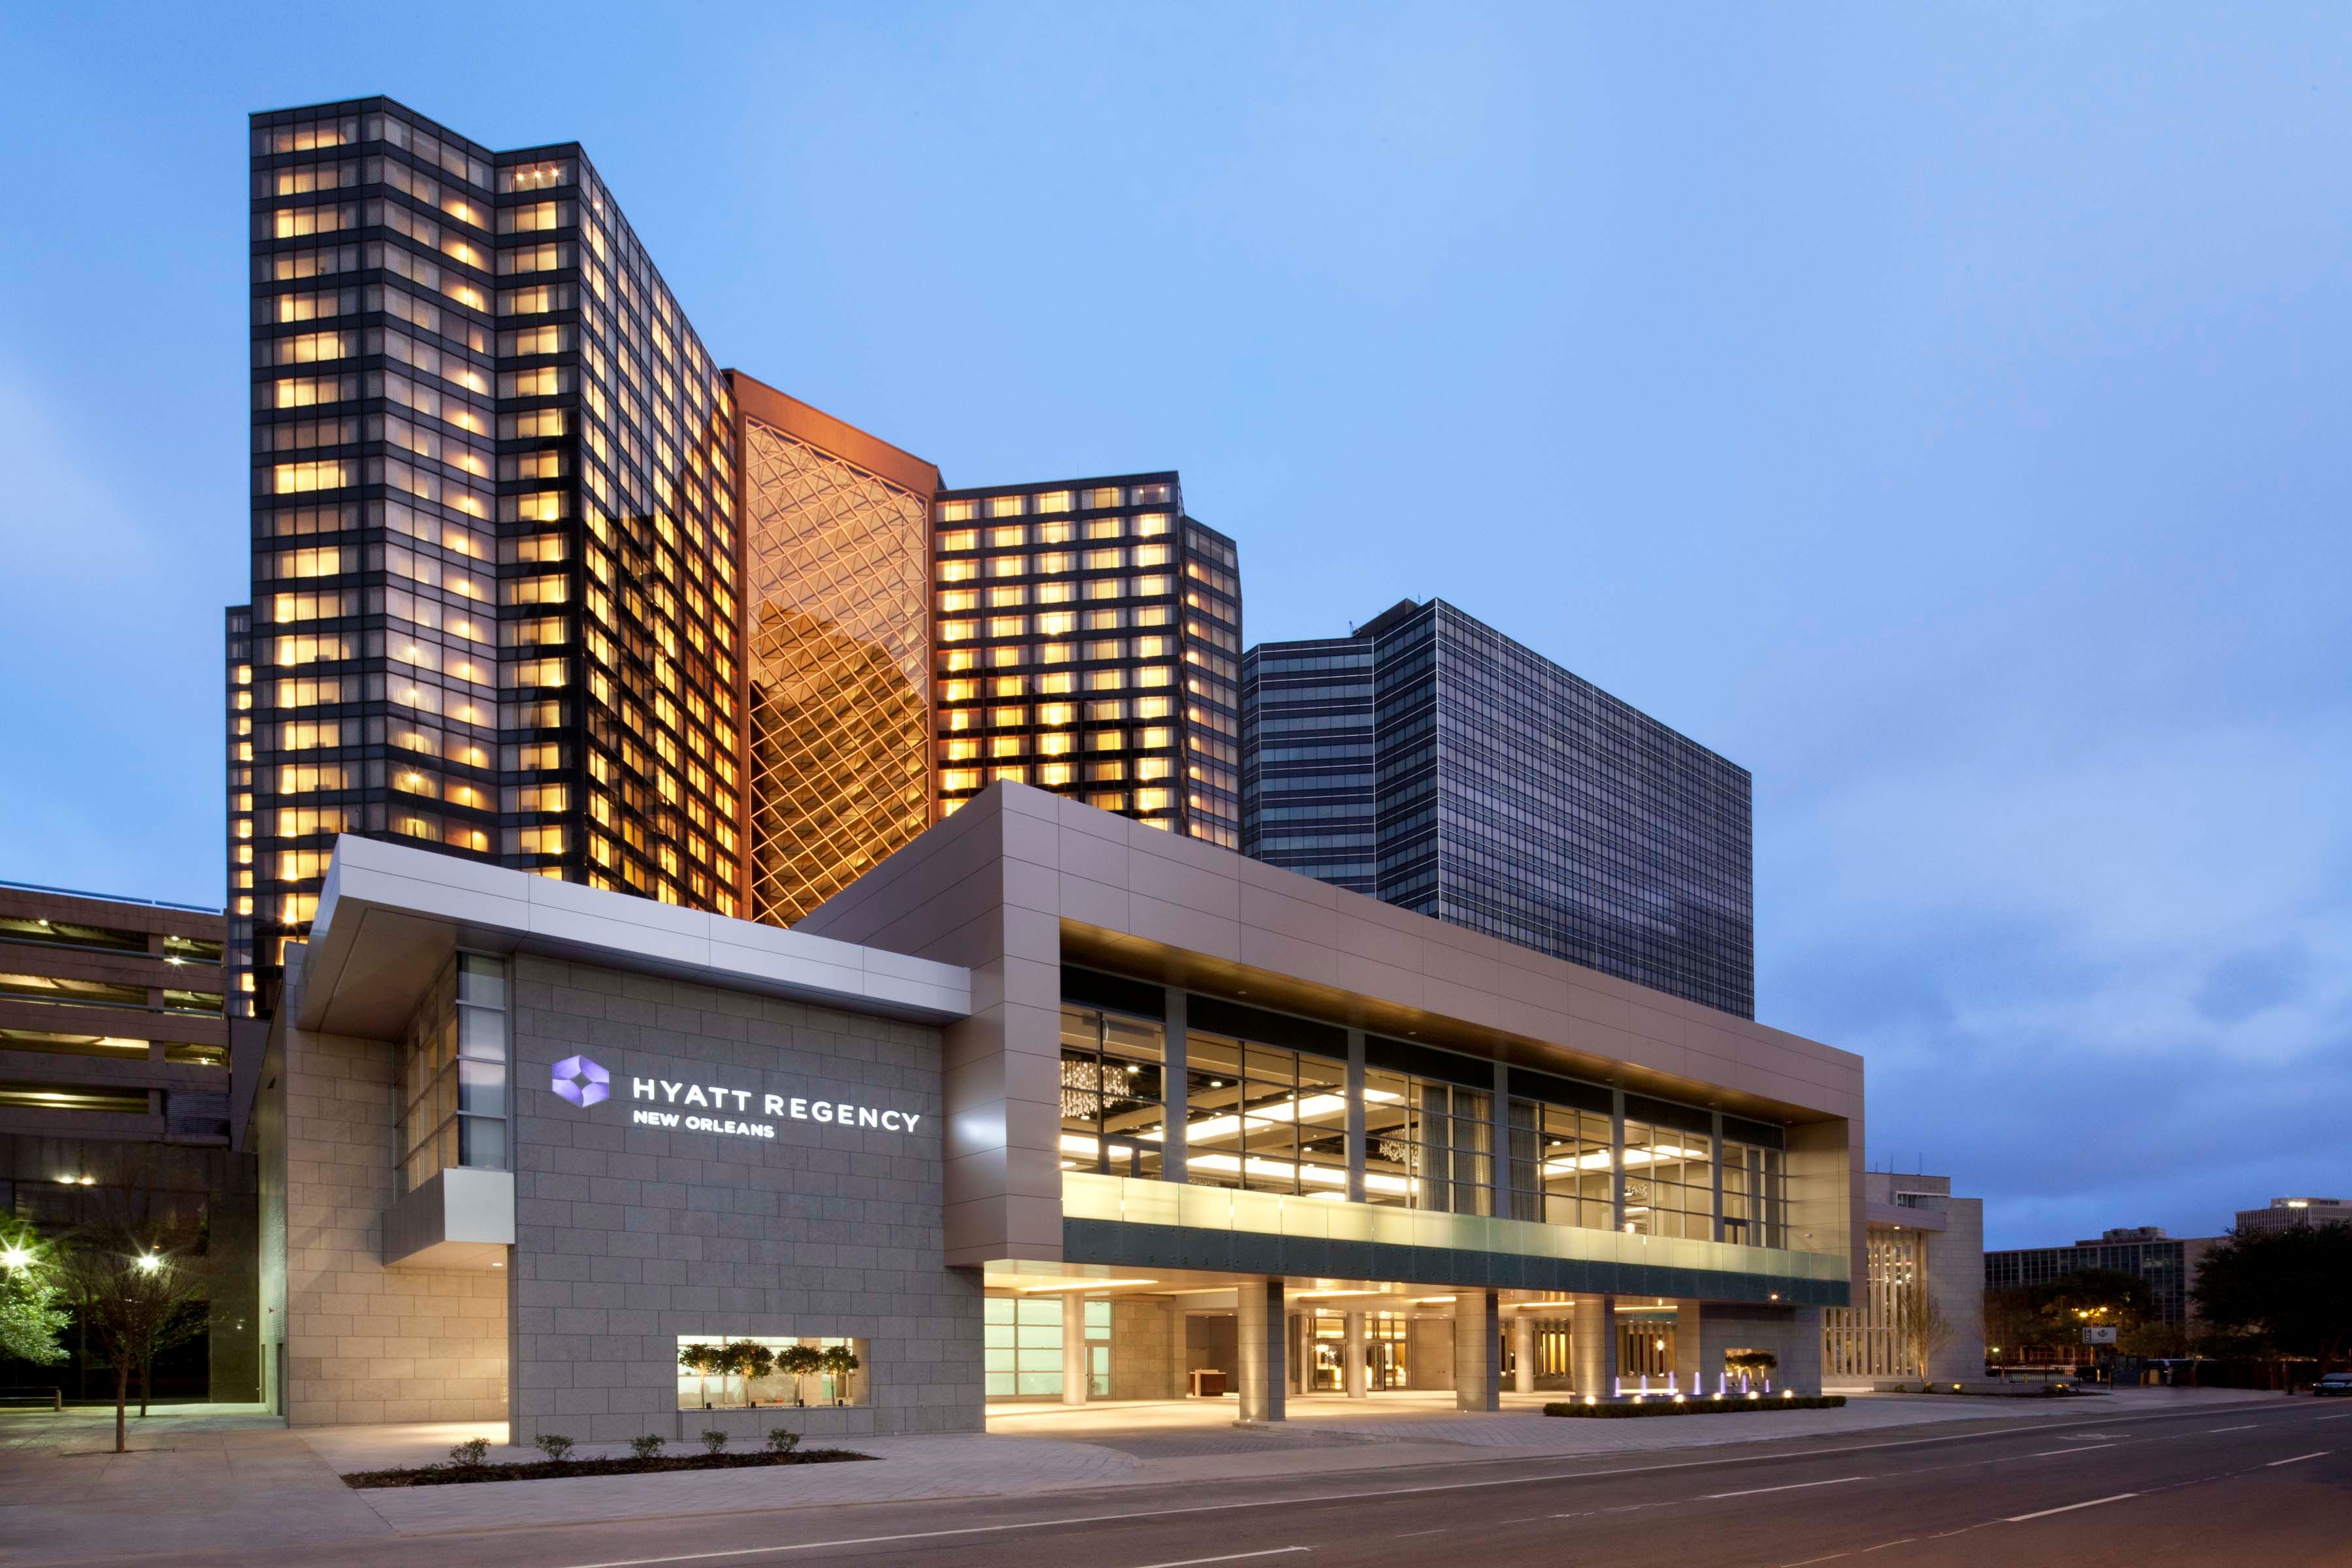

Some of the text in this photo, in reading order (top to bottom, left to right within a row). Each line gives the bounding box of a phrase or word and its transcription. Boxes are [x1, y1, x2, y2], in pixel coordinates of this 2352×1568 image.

[633, 1077, 920, 1133] HYATT REGENCY
[633, 1110, 775, 1138] NEW ORLEANS
